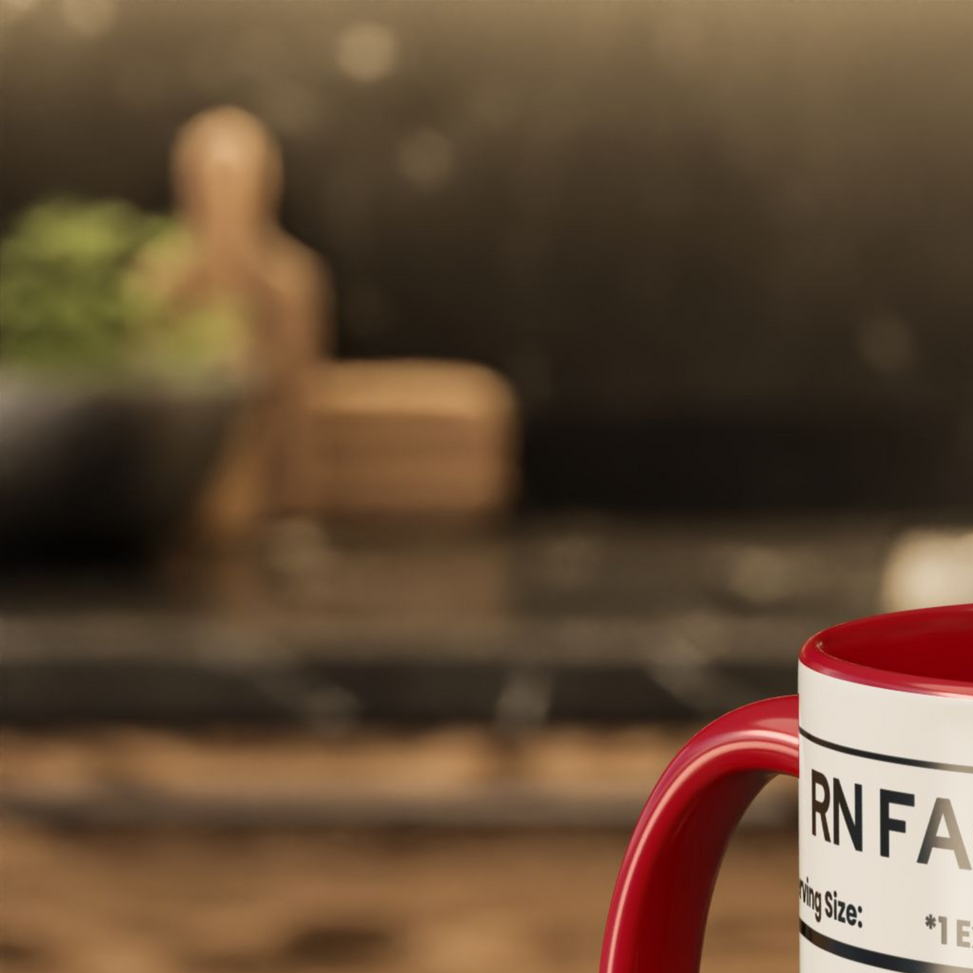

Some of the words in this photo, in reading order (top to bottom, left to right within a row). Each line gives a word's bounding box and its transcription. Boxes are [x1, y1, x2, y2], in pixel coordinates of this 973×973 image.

[811, 768, 863, 852] RN
[799, 876, 822, 923] rving
[825, 890, 863, 928] Size:
